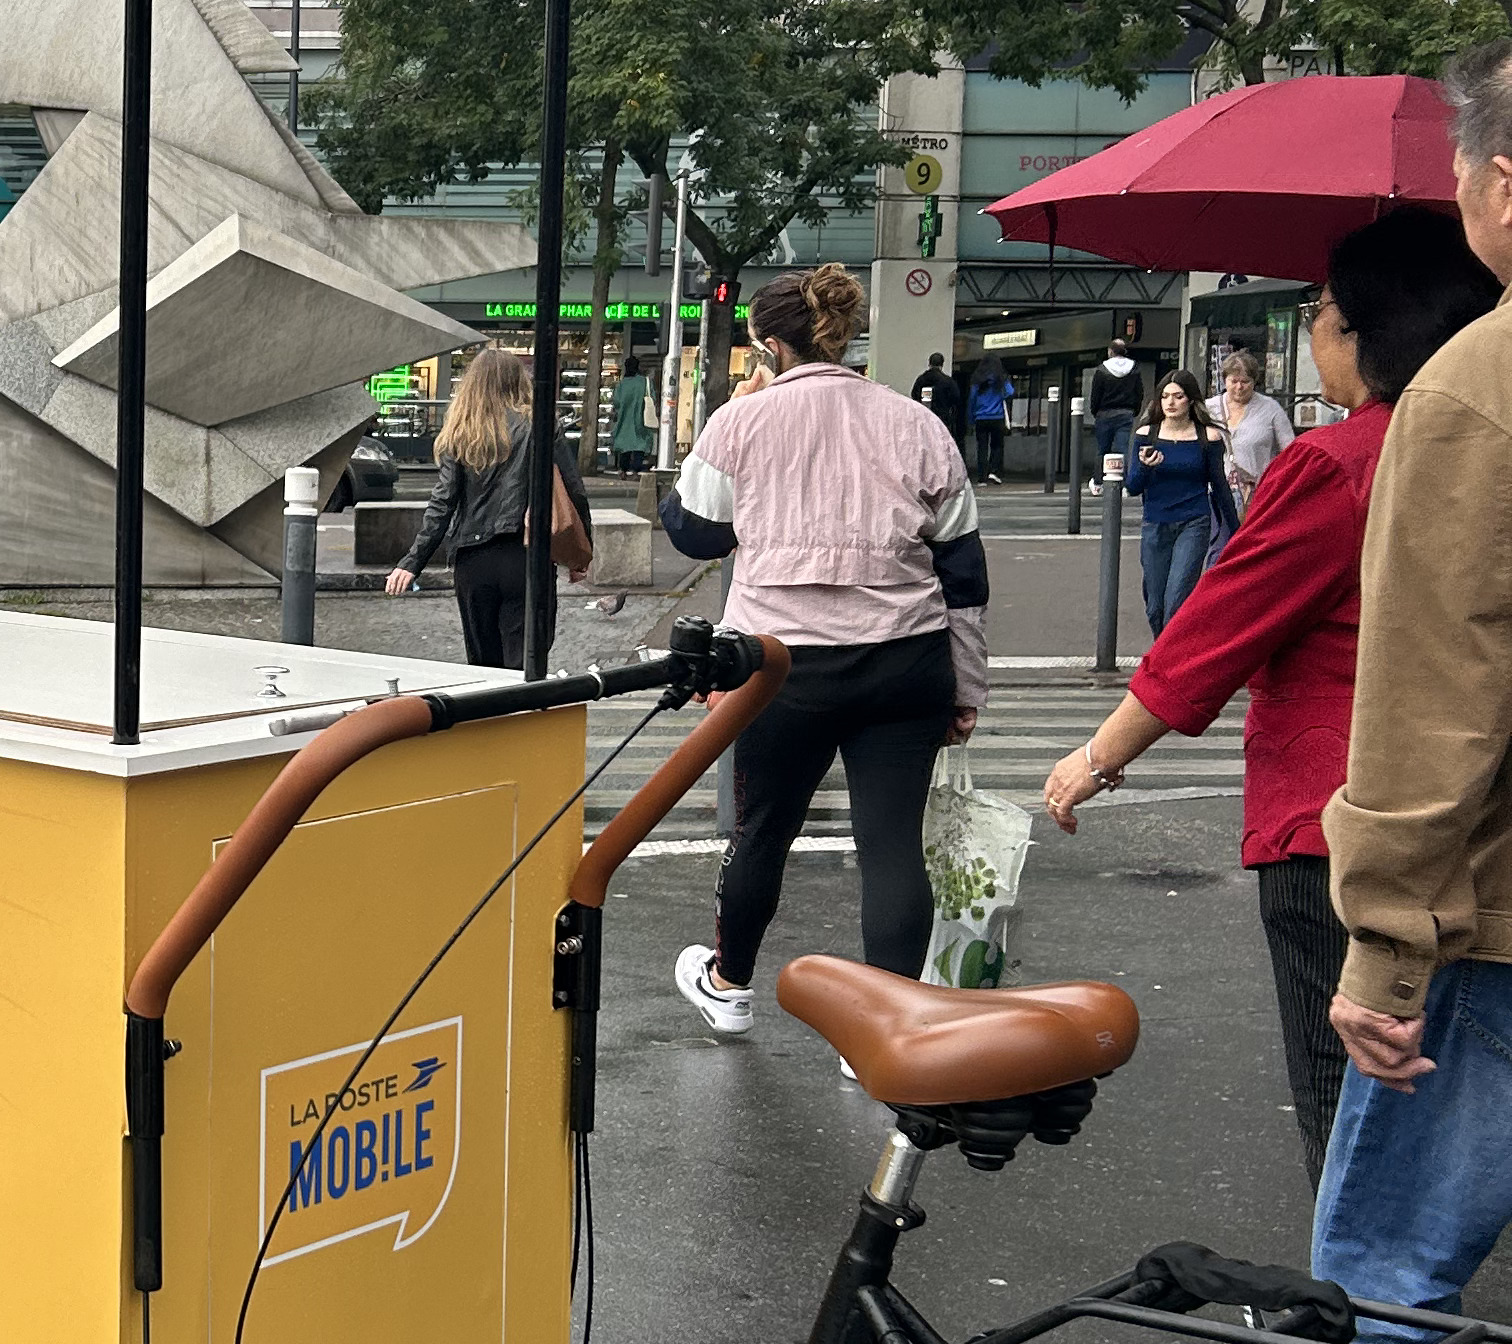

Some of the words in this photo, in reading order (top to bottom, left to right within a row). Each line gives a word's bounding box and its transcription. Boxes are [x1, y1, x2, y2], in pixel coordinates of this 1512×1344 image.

[901, 135, 949, 150] MÉTRO
[916, 162, 931, 186] 9
[486, 304, 502, 317] LA
[632, 305, 648, 318] DE
[290, 1098, 320, 1128] LA
[324, 1073, 399, 1120] POSTE
